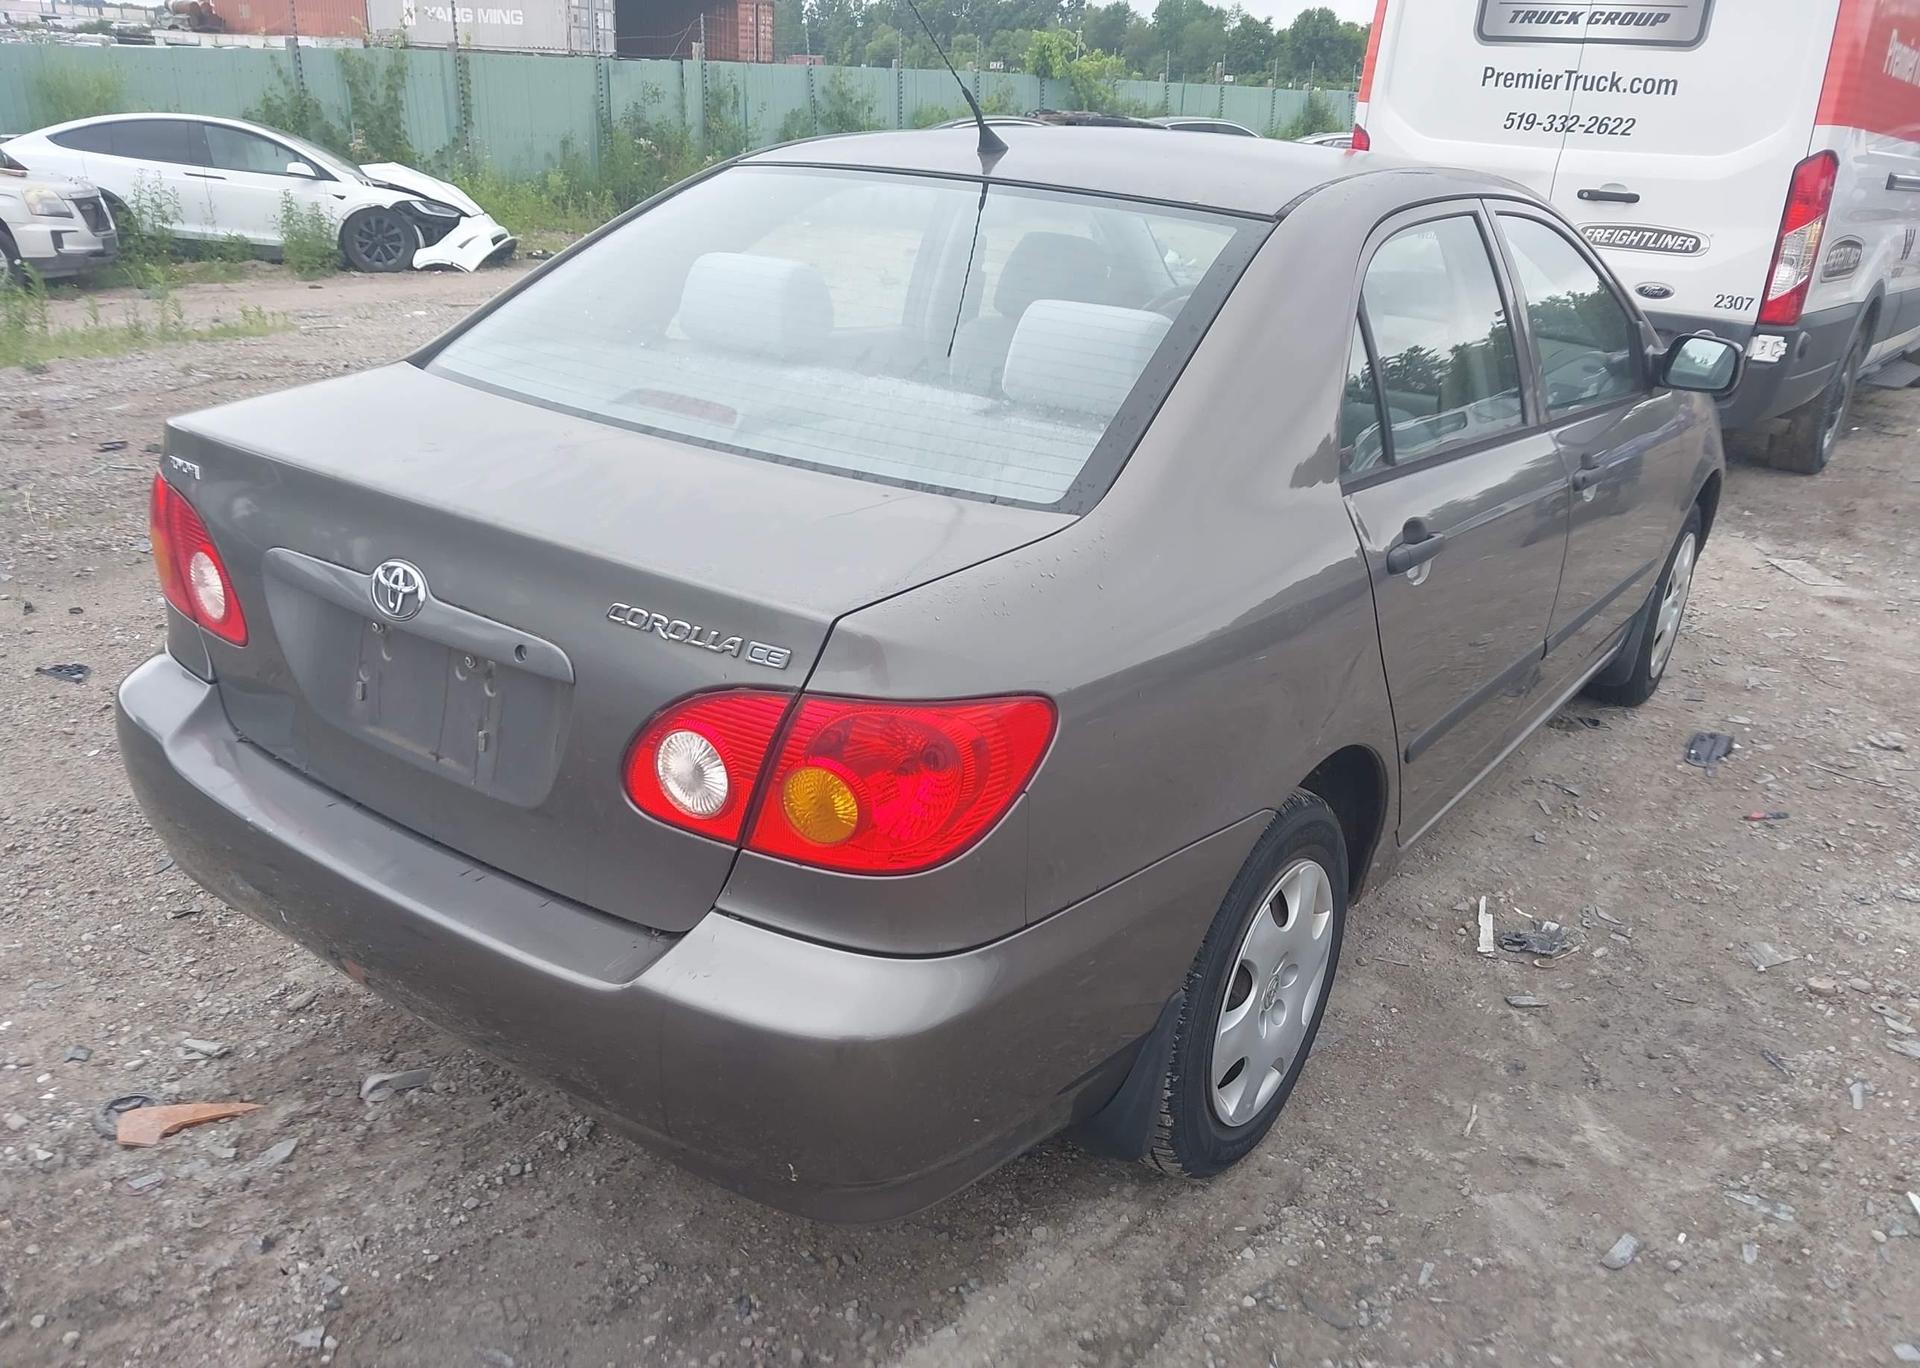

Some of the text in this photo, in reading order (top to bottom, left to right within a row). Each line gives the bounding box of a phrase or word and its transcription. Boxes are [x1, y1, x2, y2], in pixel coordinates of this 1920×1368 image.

[477, 8, 523, 25] MING
[1508, 9, 1671, 27] TRUCK GROUP
[1481, 66, 1678, 96] PremierTruck.com
[1503, 112, 1636, 136] 519-332-2622
[1584, 228, 1697, 251] FREIGHTLINER
[1713, 294, 1755, 312] 2307
[607, 602, 788, 668] COROLLA CE
